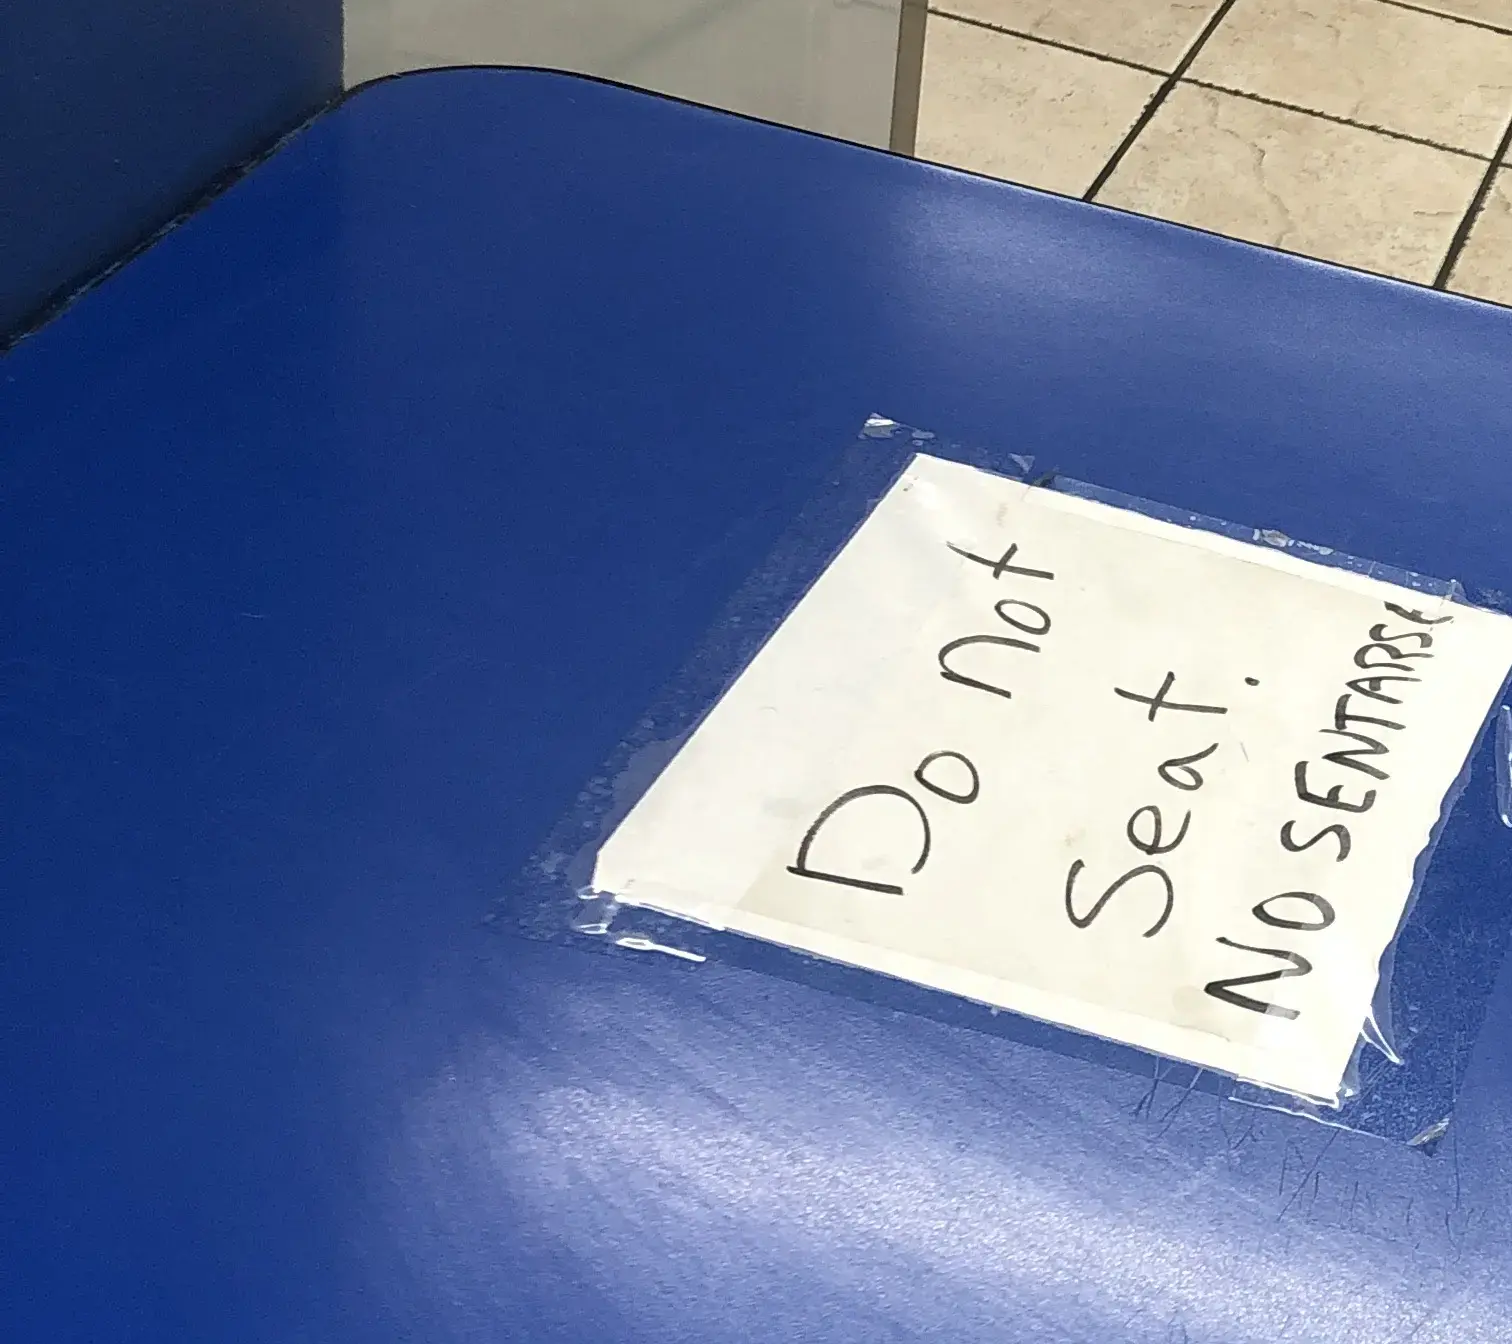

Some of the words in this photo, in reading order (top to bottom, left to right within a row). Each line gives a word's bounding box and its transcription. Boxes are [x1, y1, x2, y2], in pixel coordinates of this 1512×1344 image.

[787, 750, 981, 897] Do
[938, 542, 1055, 699] not
[1064, 670, 1261, 939] Seat.
[1203, 890, 1337, 1019] NO
